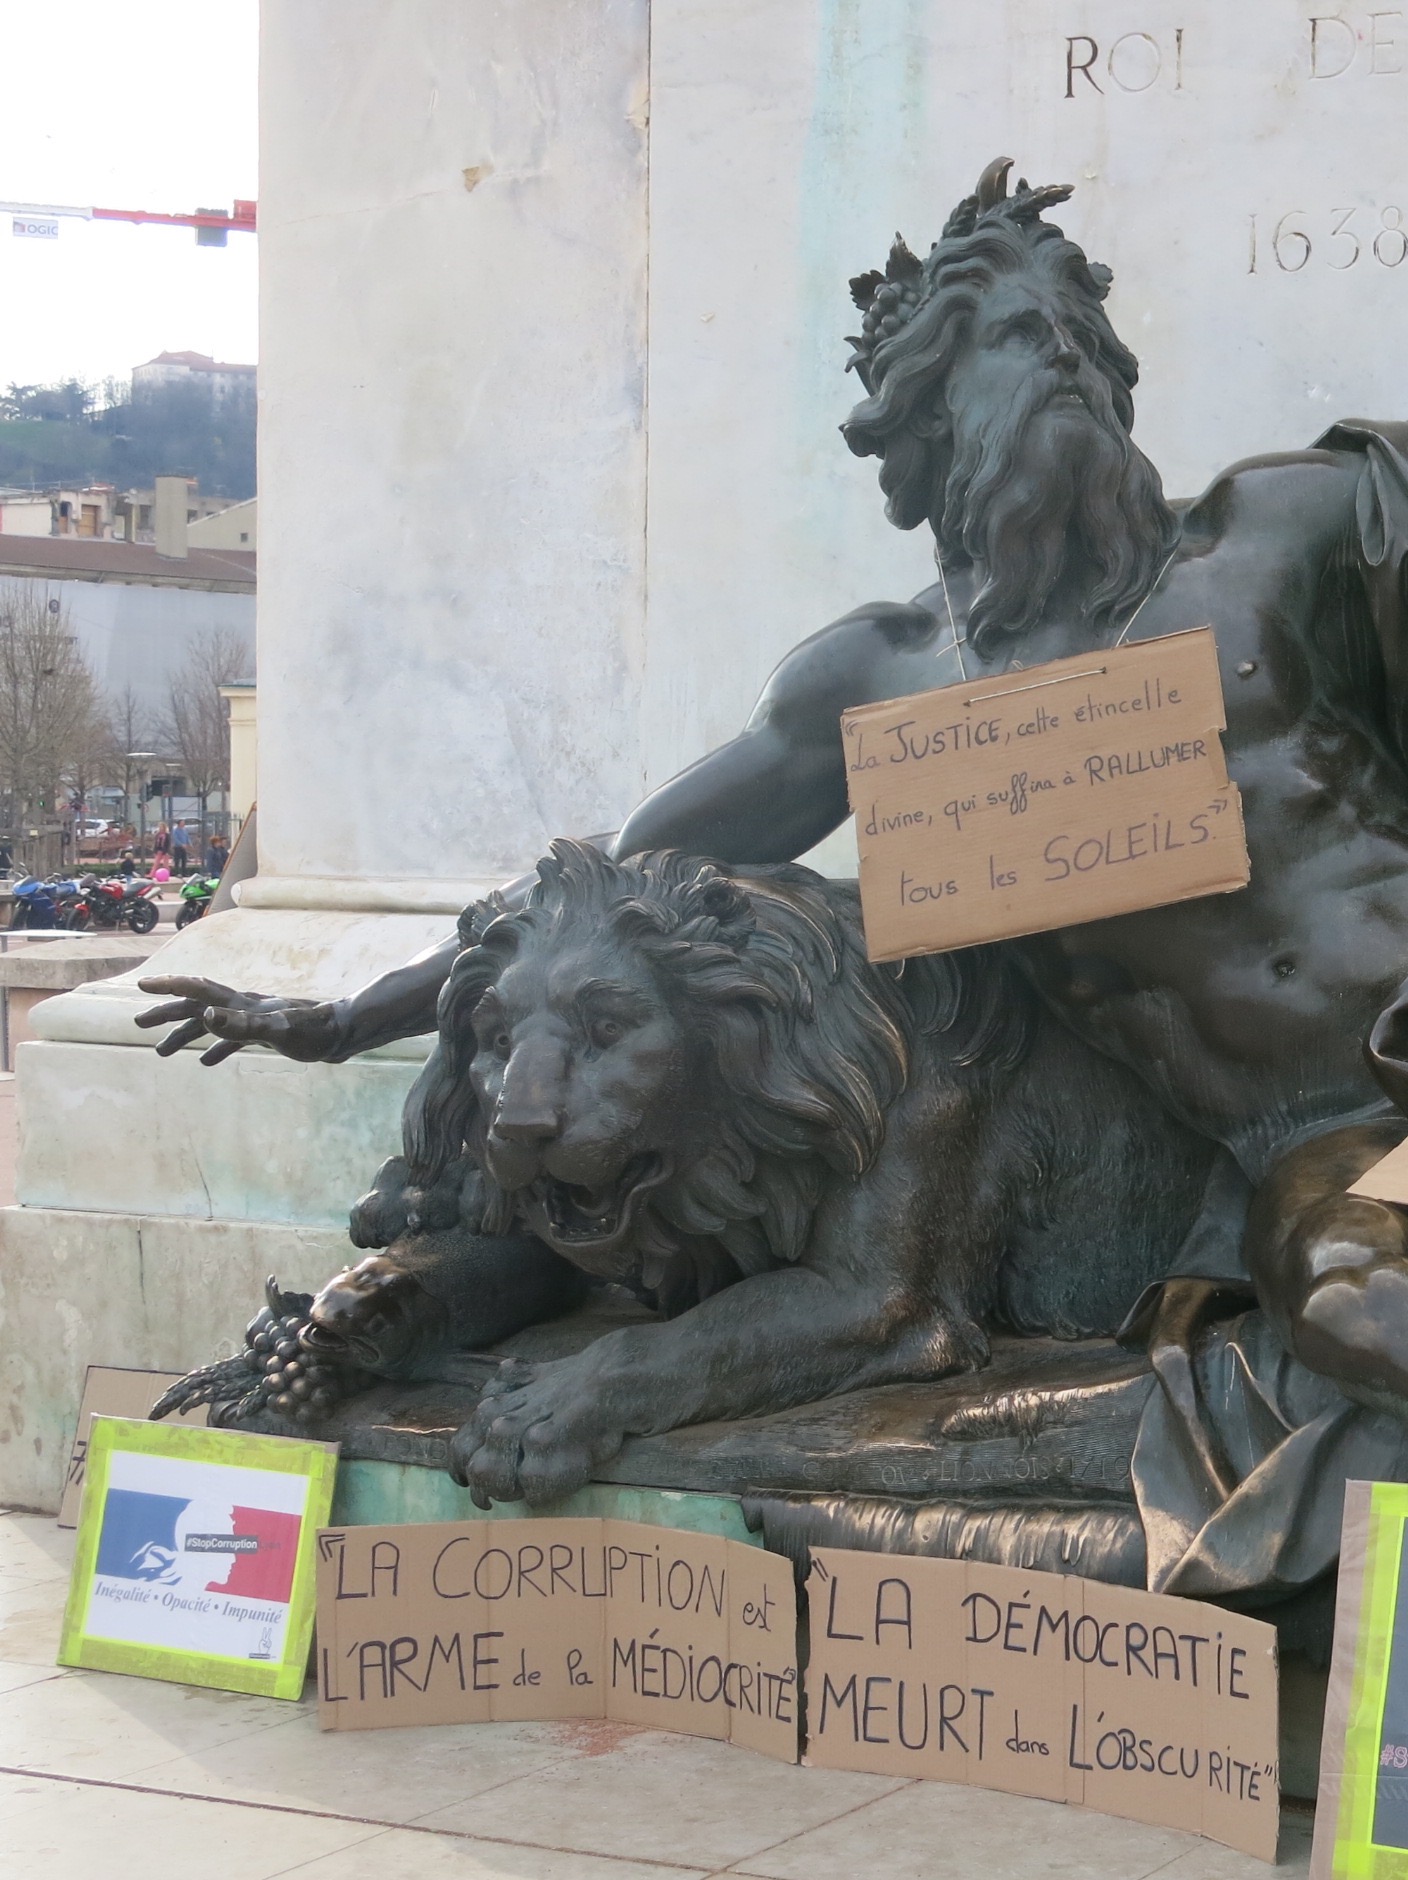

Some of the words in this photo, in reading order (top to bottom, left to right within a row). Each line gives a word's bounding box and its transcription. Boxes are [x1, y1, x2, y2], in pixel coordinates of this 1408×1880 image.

[1063, 27, 1187, 100] ROI
[1307, 10, 1405, 81] DE
[1016, 706, 1060, 738] cette
[1073, 678, 1183, 723] étincelle
[865, 803, 933, 836] divine,
[943, 794, 976, 831] qui
[1063, 771, 1077, 786] à
[1084, 740, 1208, 787] RALLUMER
[900, 870, 960, 907] tous
[988, 855, 1018, 891] les
[186, 1537, 258, 1550] #StopCorruption
[95, 1581, 152, 1604] Inégalité
[162, 1591, 211, 1613] Opacité
[222, 1601, 283, 1625] Impunité
[743, 1583, 776, 1632] est
[323, 1631, 504, 1702] L'ARME
[513, 1648, 542, 1687] de
[566, 1648, 594, 1686] la
[819, 1672, 995, 1762] MEURT
[1005, 1709, 1050, 1757] dans
